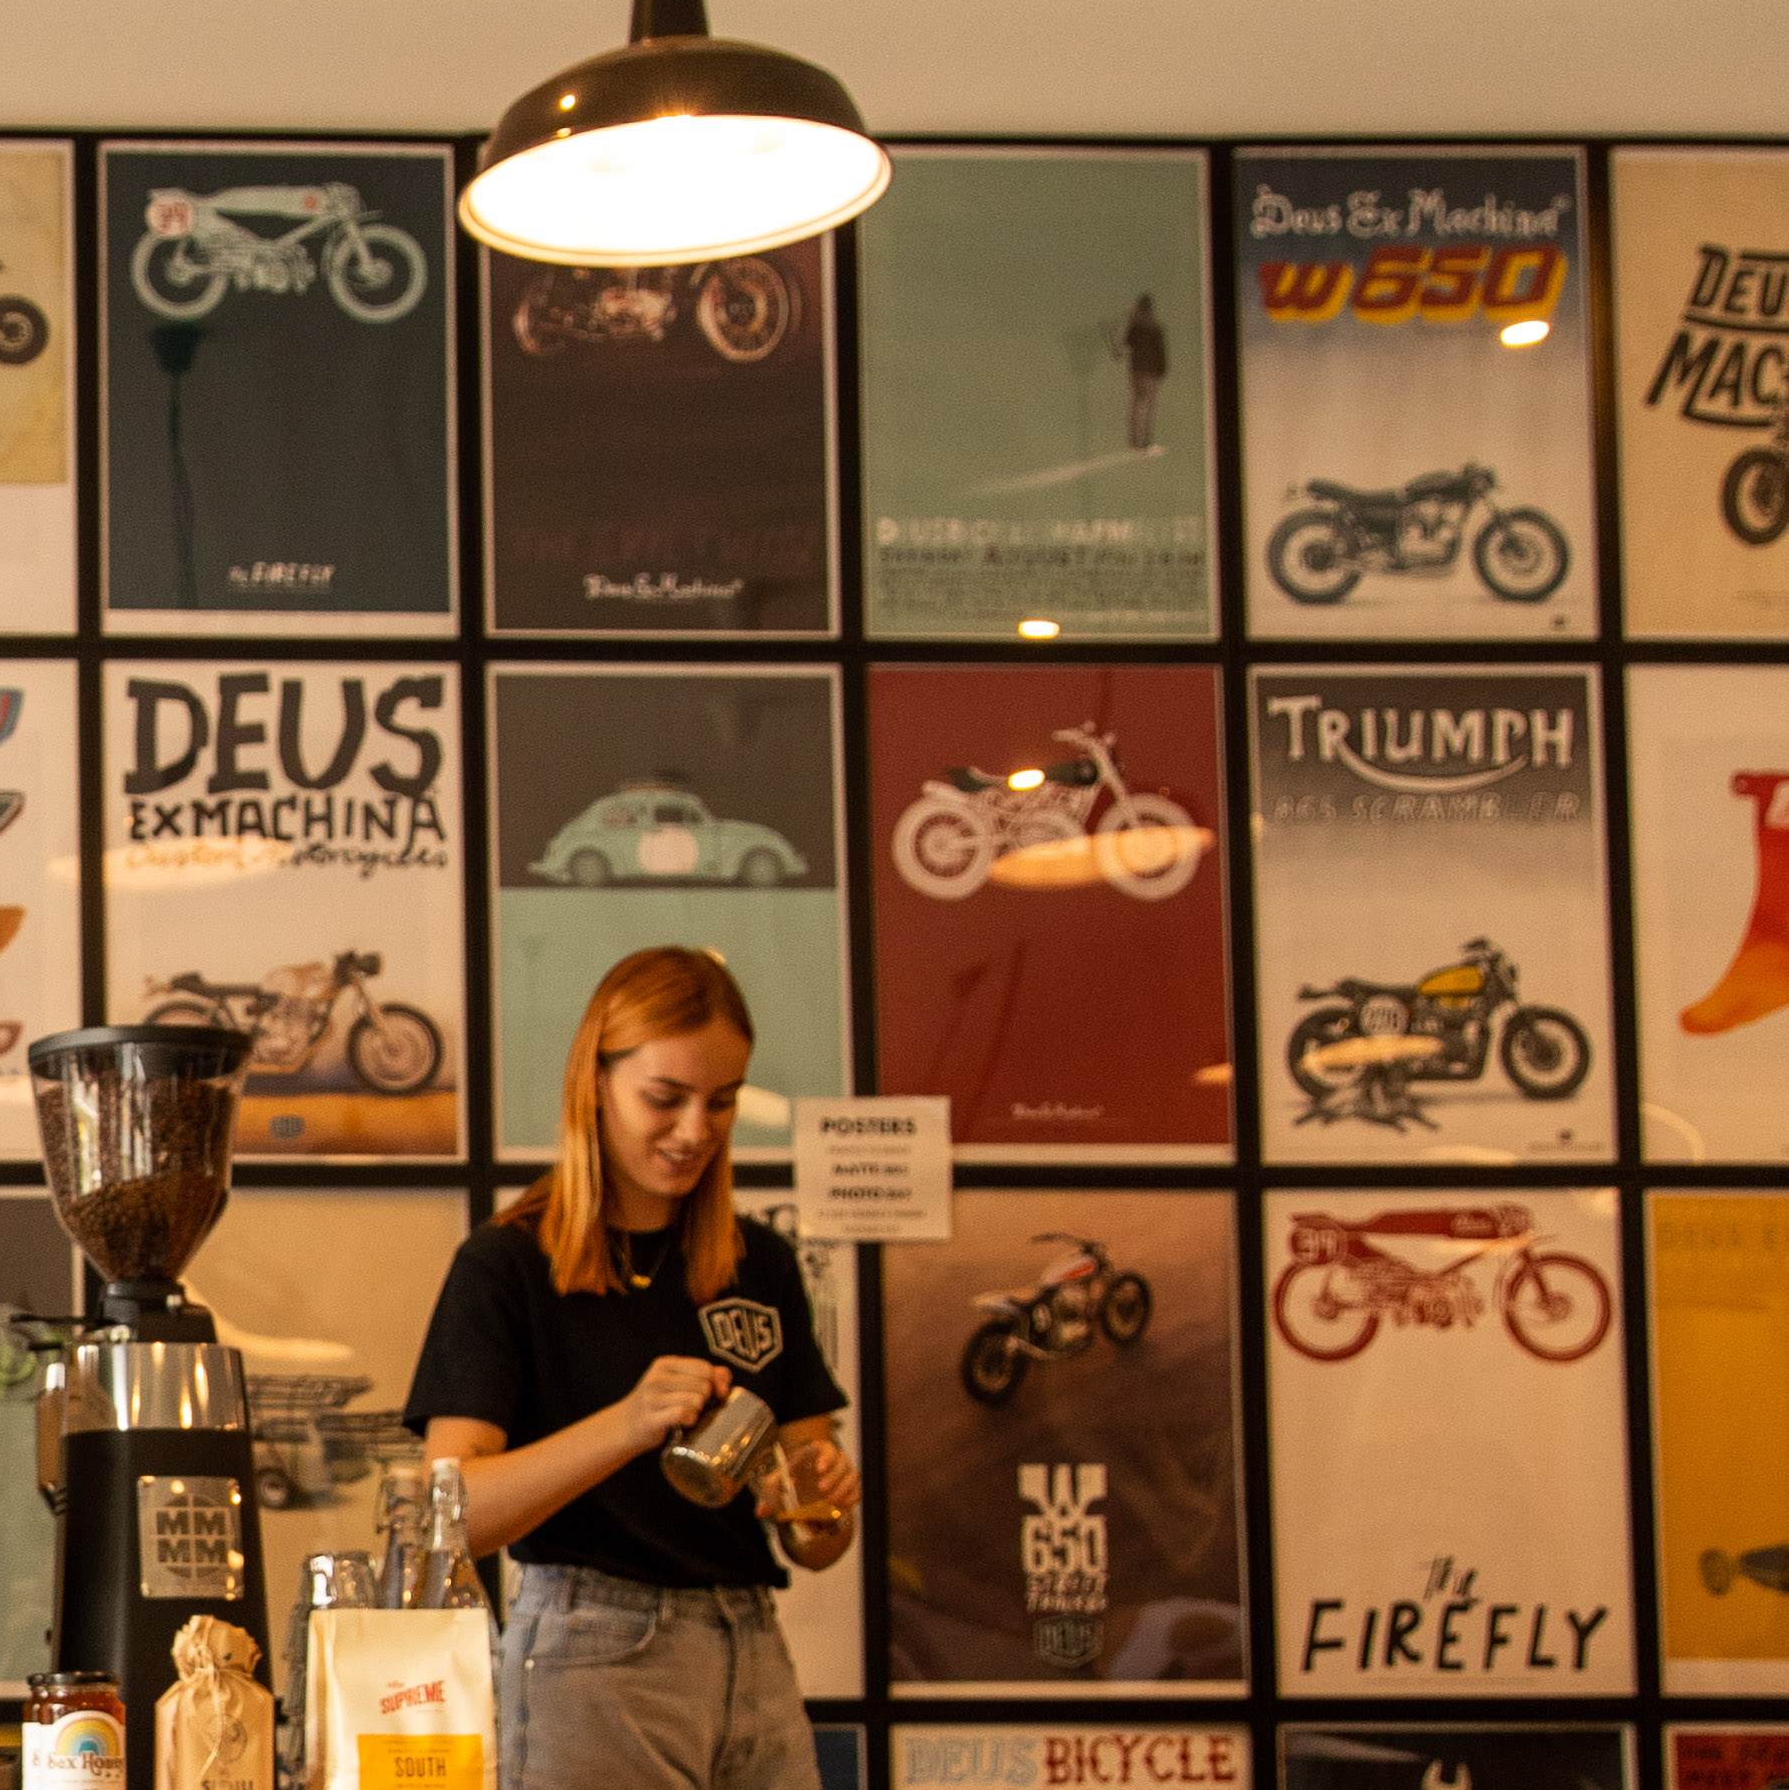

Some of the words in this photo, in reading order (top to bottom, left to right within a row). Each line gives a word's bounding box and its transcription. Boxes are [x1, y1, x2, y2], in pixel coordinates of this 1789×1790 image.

[1250, 183, 1344, 239] Deus
[122, 671, 447, 798] DEUS
[1266, 695, 1577, 769] TRIUMPH
[819, 1115, 918, 1135] POSTERS
[710, 1308, 774, 1360] DEUS
[1018, 1463, 1108, 1517] W
[1021, 1514, 1109, 1575] 650
[1300, 1597, 1610, 1674] FIREFLY
[379, 1679, 447, 1715] SUPREME
[394, 1756, 447, 1778] SOUTH
[1043, 1733, 1236, 1785] BICYCLE
